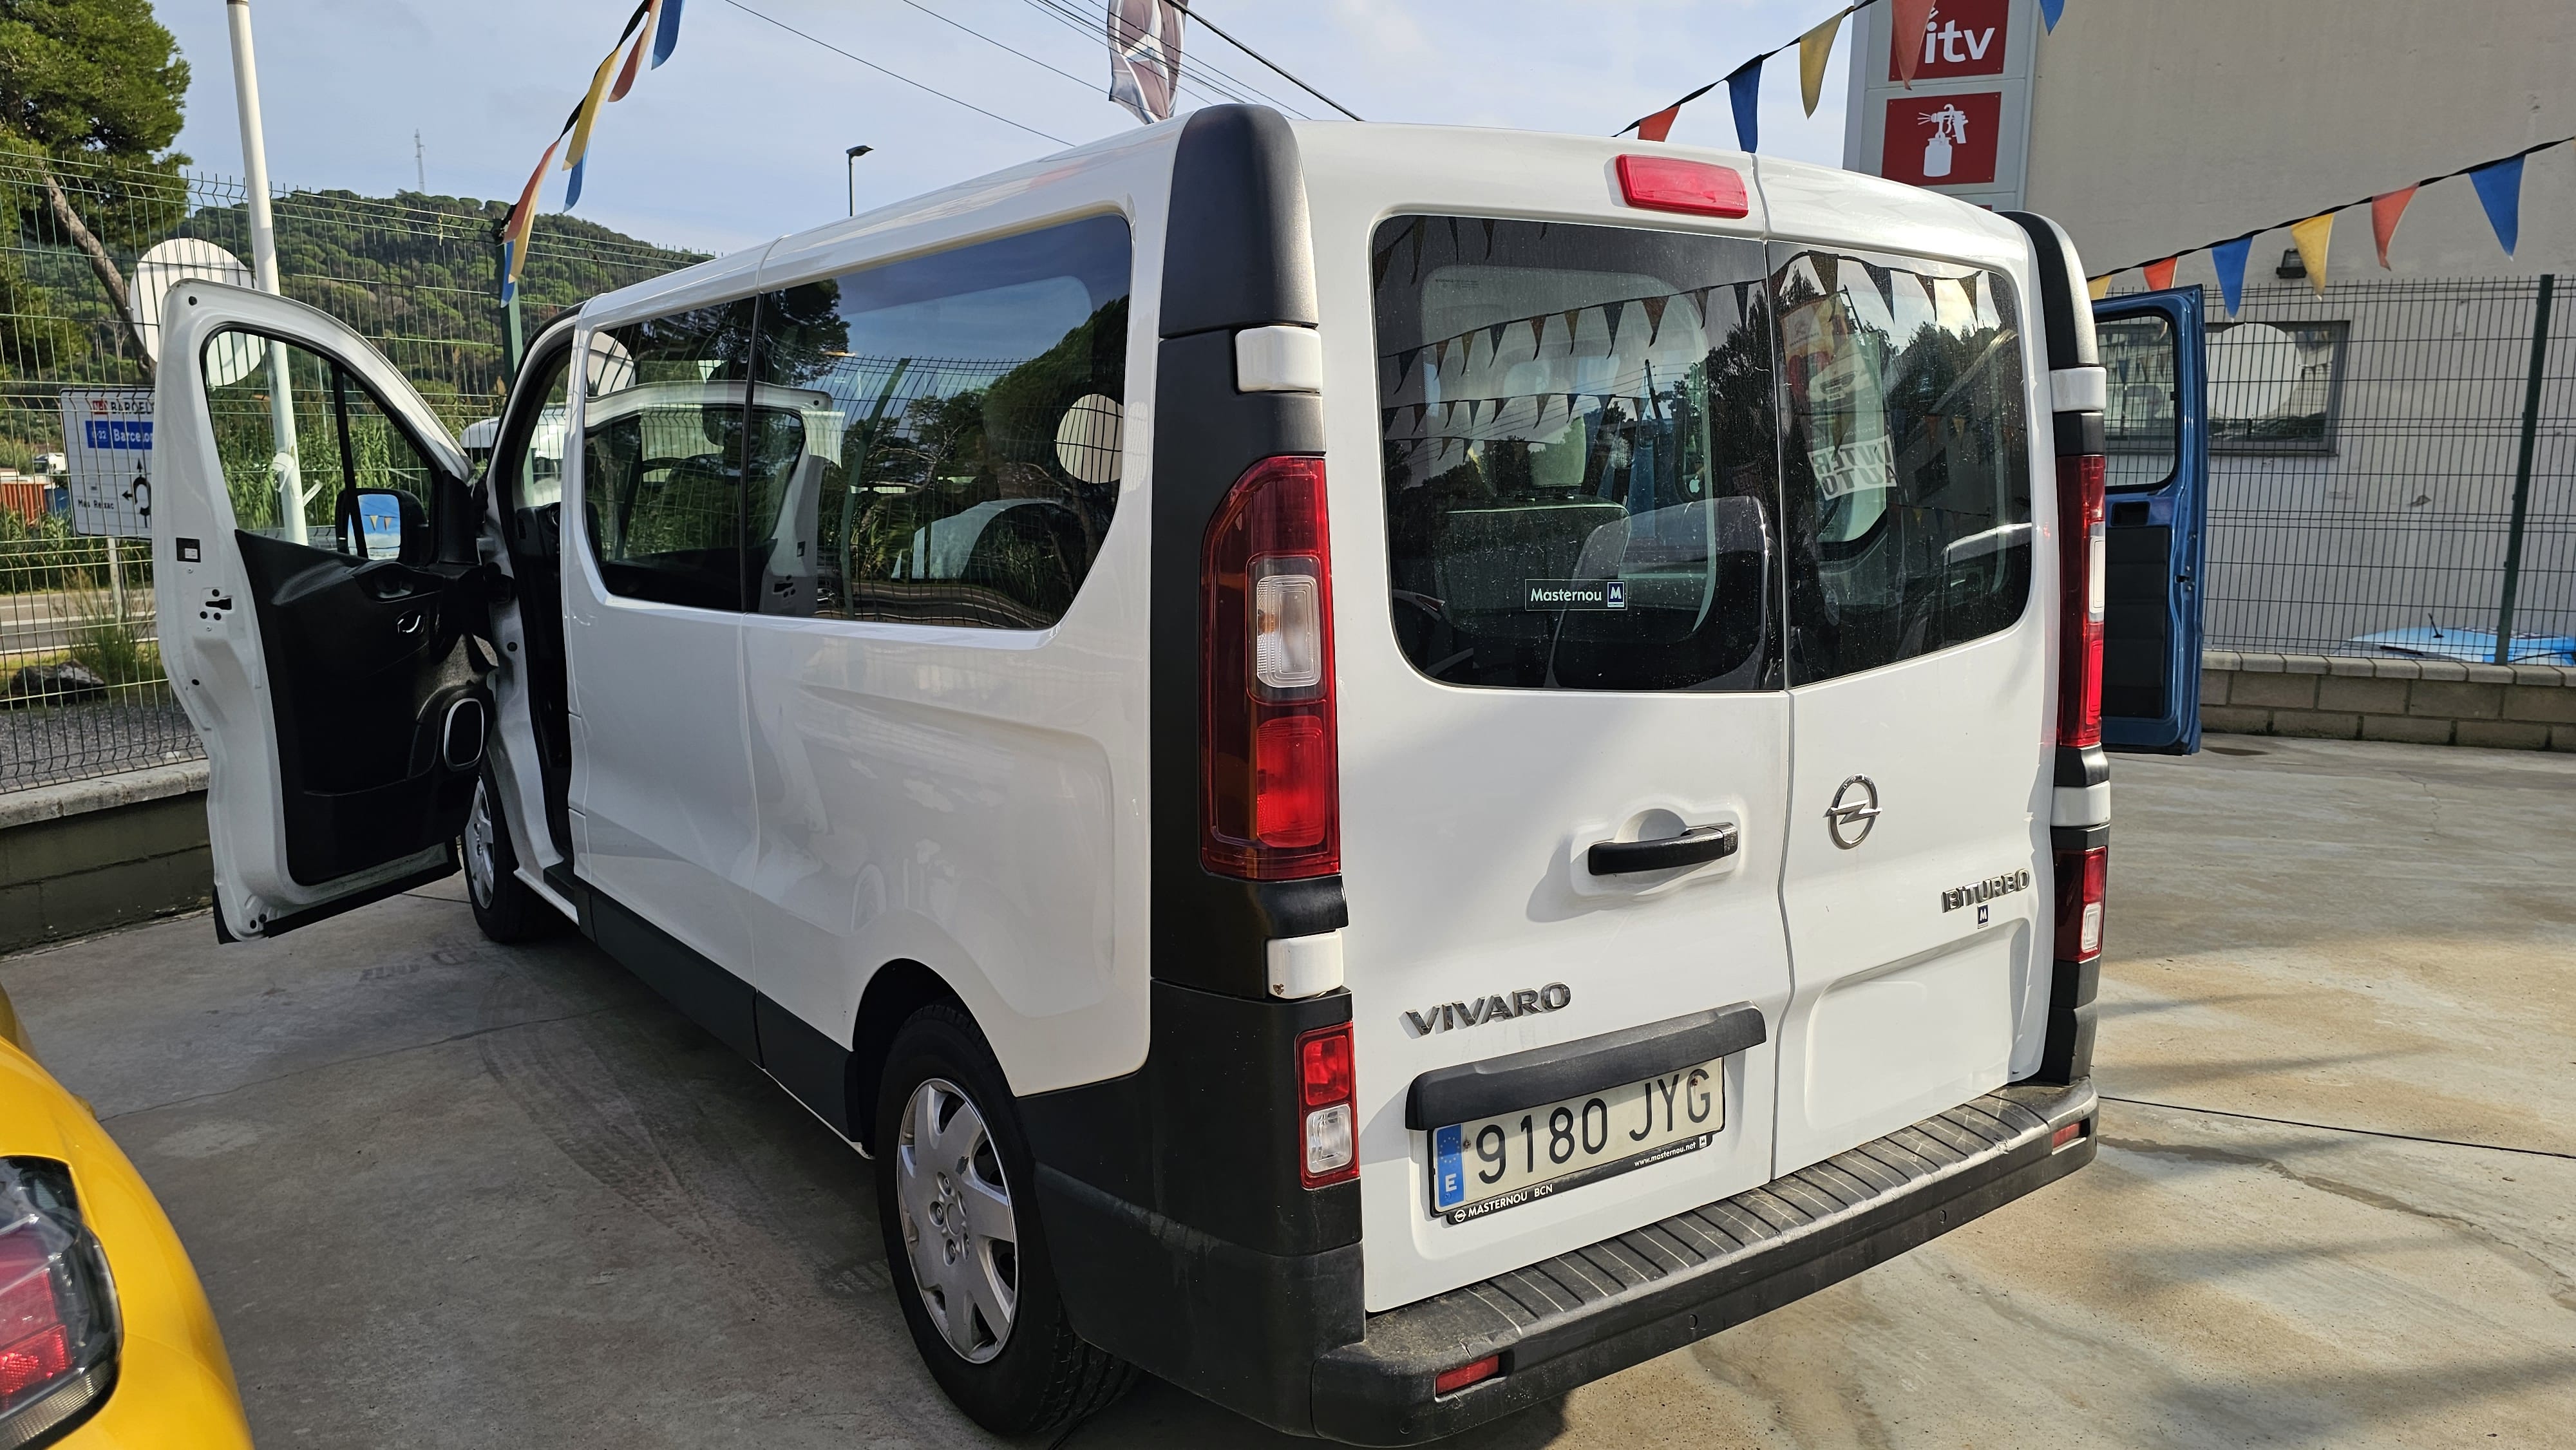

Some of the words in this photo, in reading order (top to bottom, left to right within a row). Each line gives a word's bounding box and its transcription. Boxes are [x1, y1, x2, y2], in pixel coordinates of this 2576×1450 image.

[1924, 19, 1995, 64] itv
[111, 401, 154, 414] BARCEL
[1530, 588, 1602, 601] Masternou
[1610, 586, 1622, 599] M
[1979, 909, 1987, 921] M
[1405, 981, 1571, 1036] VIVARO
[1476, 1097, 1608, 1184] 9180
[1629, 1069, 1711, 1142] JYG
[1634, 1142, 1696, 1167] www.masternou.net
[1444, 1173, 1457, 1192] E
[1468, 1191, 1528, 1218] MASTERNOU
[1534, 1183, 1553, 1198] BCN
